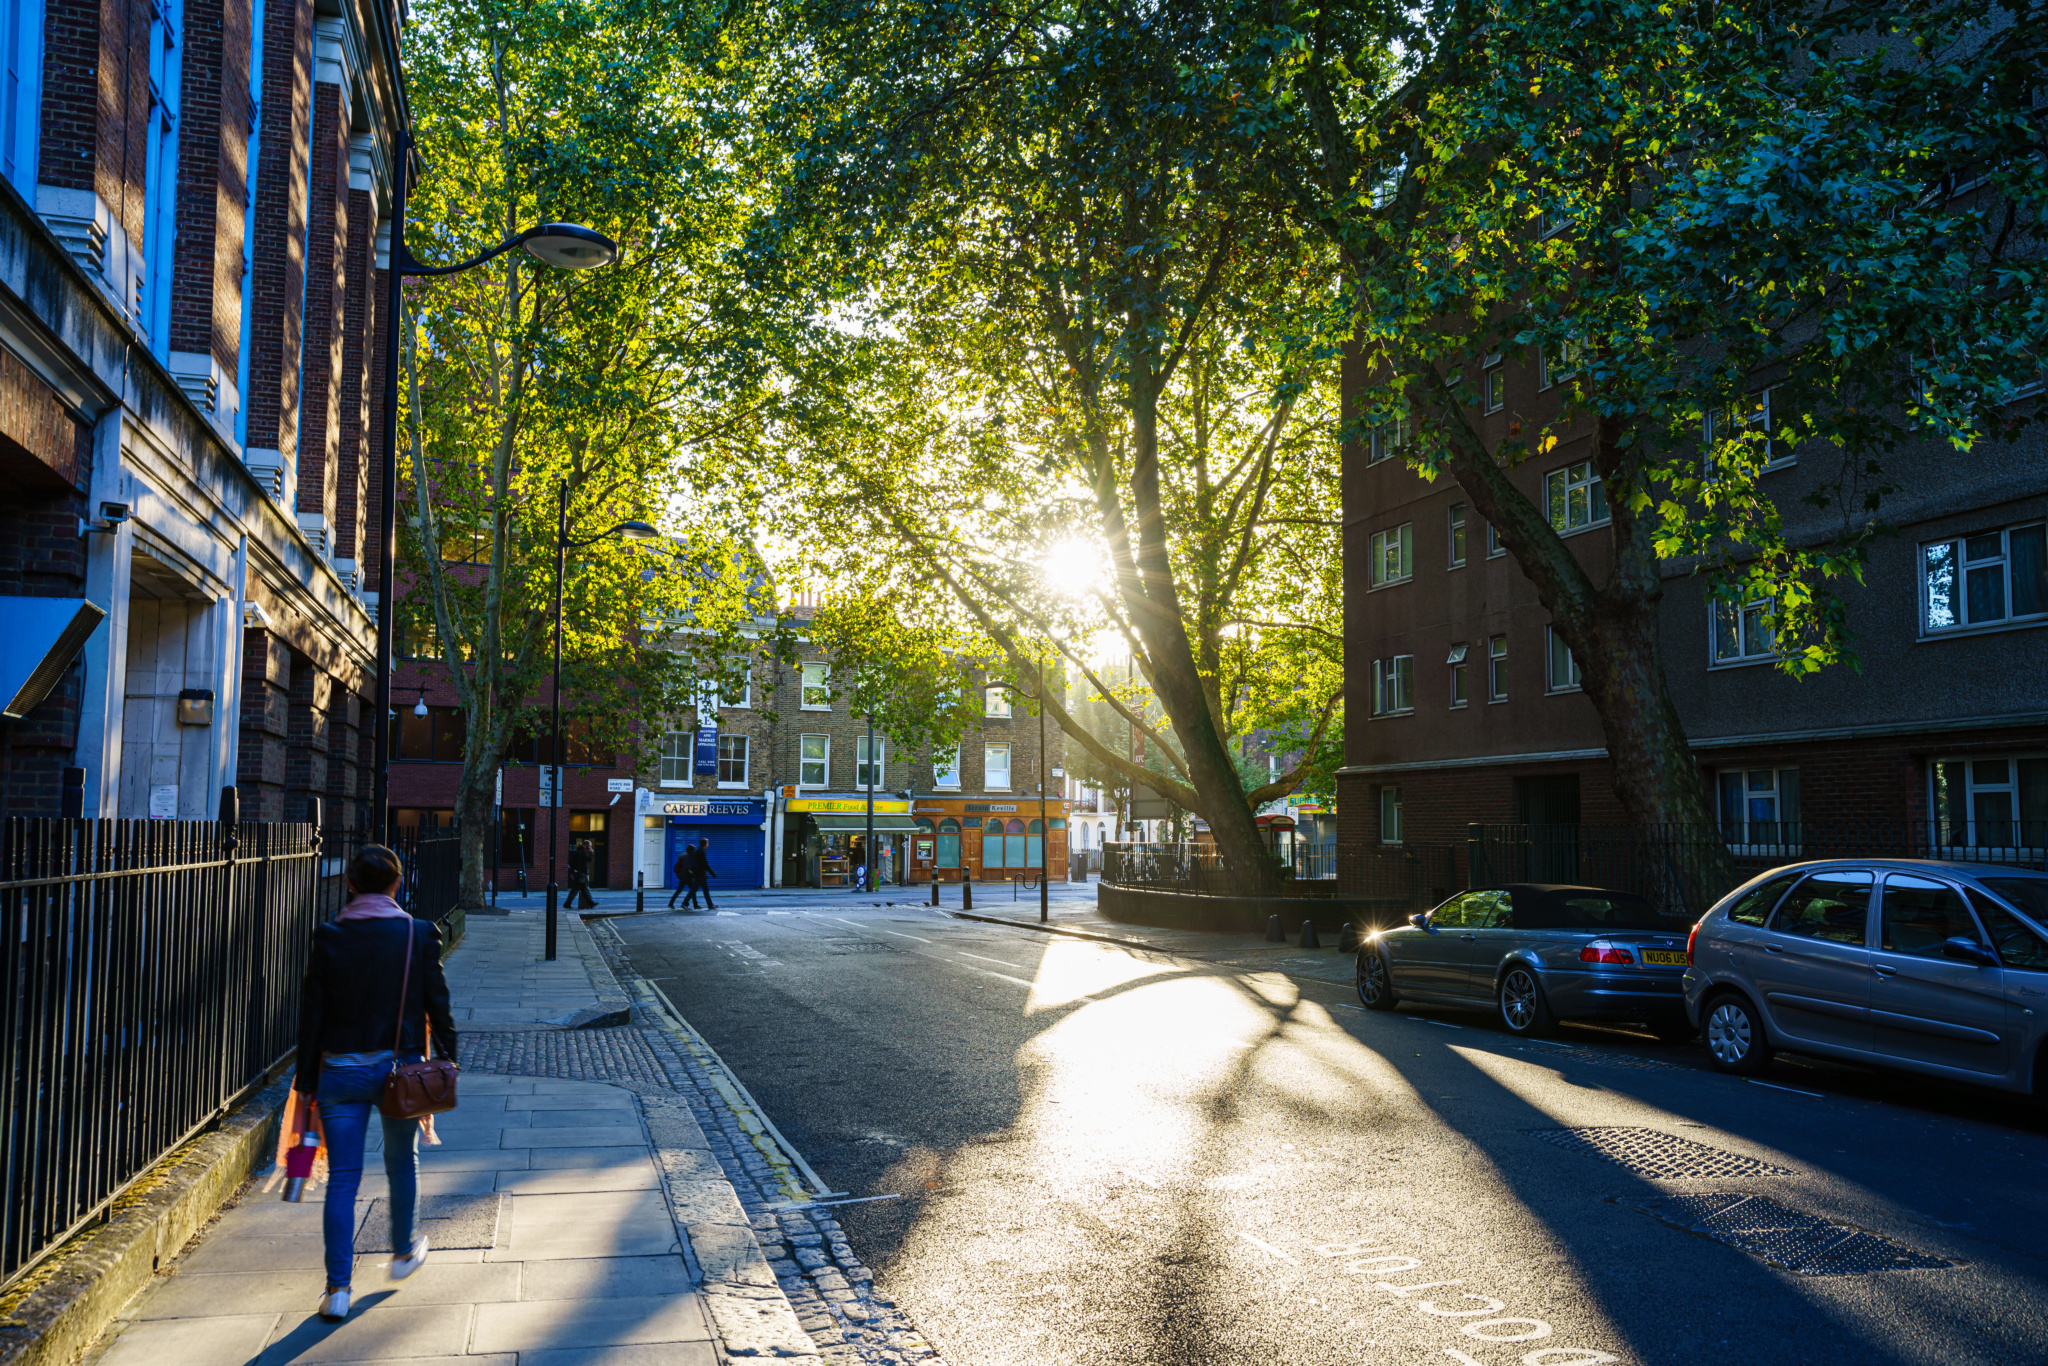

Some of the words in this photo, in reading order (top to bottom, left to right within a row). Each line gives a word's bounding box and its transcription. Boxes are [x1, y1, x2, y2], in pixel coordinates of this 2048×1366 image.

[663, 803, 706, 814] CARTER
[708, 804, 749, 815] REEVES
[807, 801, 842, 811] PREMIER
[843, 803, 859, 811] Food
[860, 803, 867, 811] &
[1646, 951, 1672, 963] NU06
[1673, 953, 1688, 965] US
